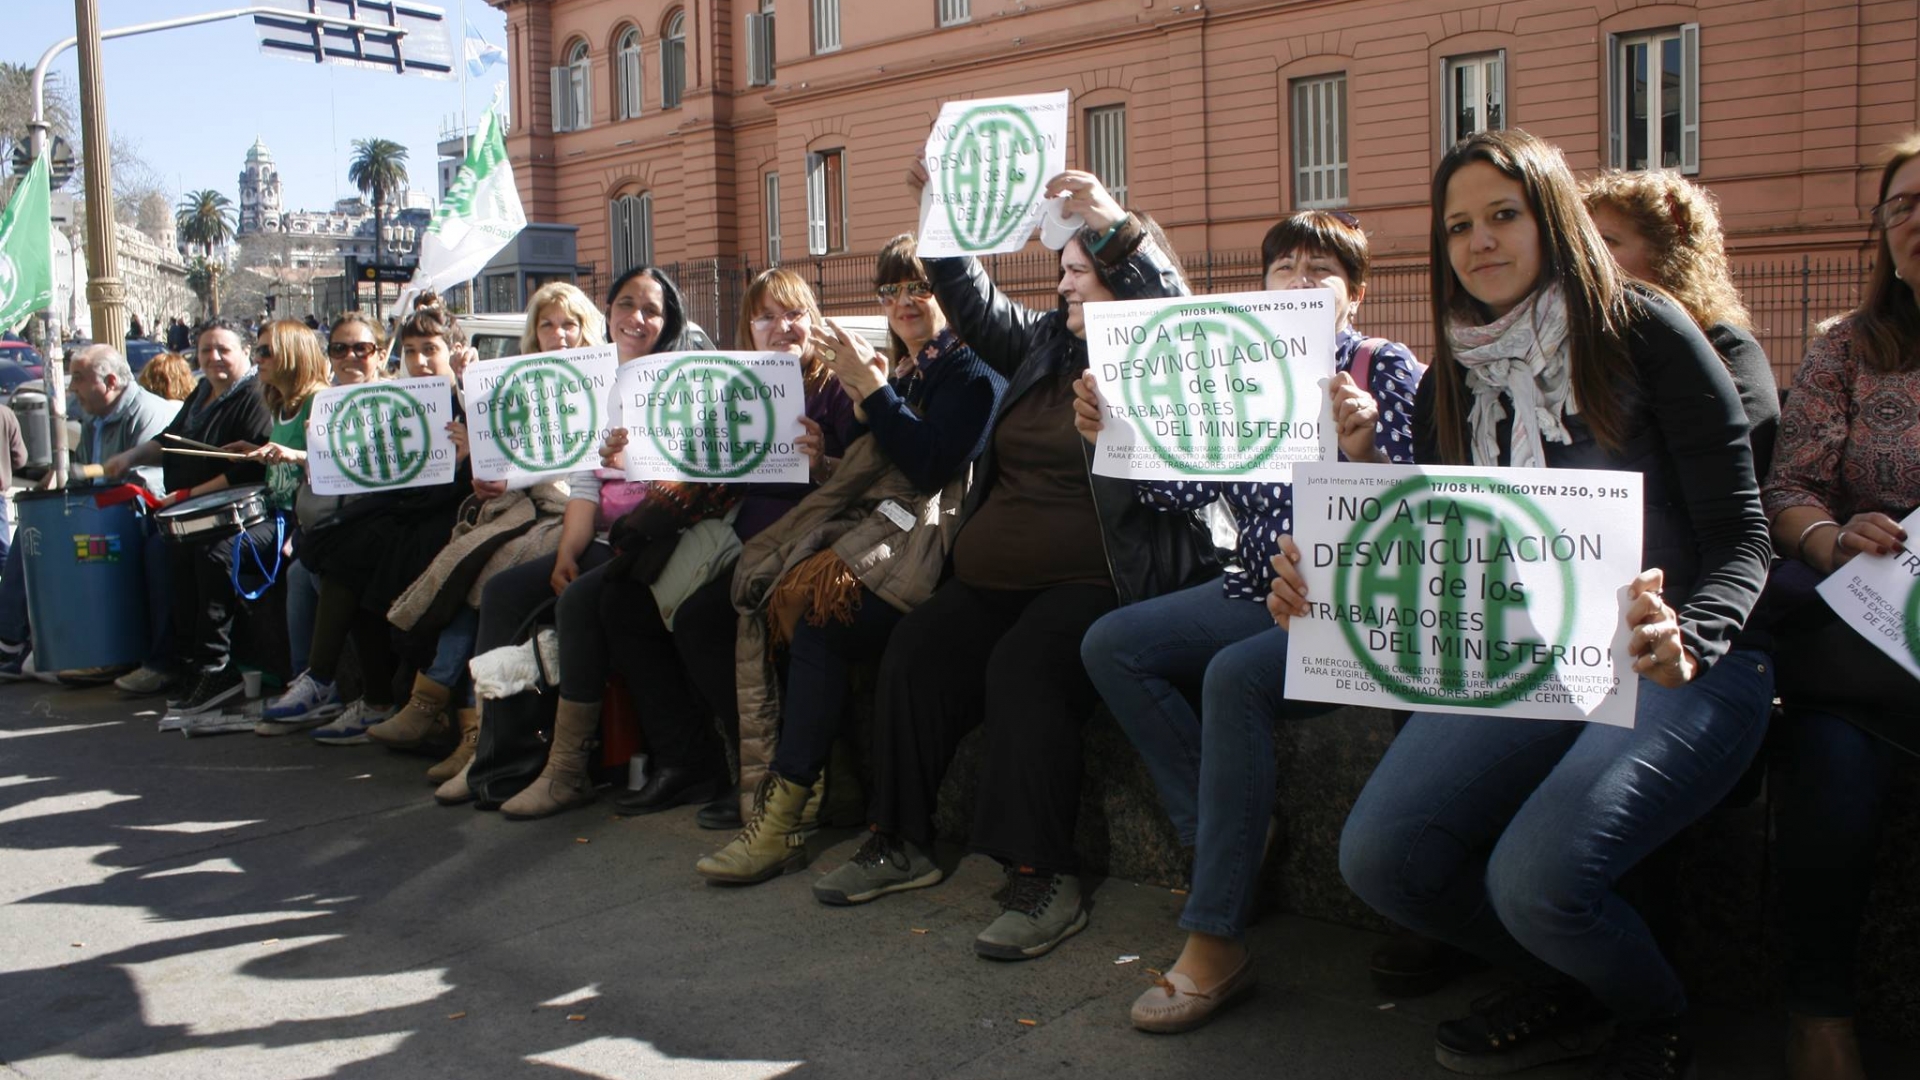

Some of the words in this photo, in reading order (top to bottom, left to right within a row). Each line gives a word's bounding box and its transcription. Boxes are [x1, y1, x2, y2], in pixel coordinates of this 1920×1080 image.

[966, 123, 974, 136] A
[1180, 308, 1206, 318] 17/08
[1208, 307, 1219, 317] H.
[1221, 303, 1271, 315] YRIGOYEN
[1273, 302, 1298, 313] 250,
[1301, 302, 1307, 310] 9
[1309, 300, 1324, 310] HS
[1107, 325, 1147, 346] ¡NO
[1156, 324, 1171, 343] A
[1178, 321, 1207, 341] LA
[1102, 333, 1307, 383] DESVINCULACIÓN
[511, 373, 521, 386] A
[525, 370, 543, 384] LA
[676, 369, 687, 382] A
[693, 369, 713, 382] LA
[1189, 375, 1216, 395] de
[1225, 374, 1258, 393] los
[349, 400, 359, 410] A
[362, 397, 380, 409] LA
[477, 374, 604, 415] DESVINCULACIÓN
[634, 382, 785, 408] DESVINCULACIÓN
[533, 404, 550, 418] de
[556, 402, 576, 416] los
[698, 407, 717, 422] de
[725, 409, 749, 422] los
[1107, 401, 1234, 420] TRABAJADORES
[369, 427, 385, 440] de
[390, 425, 411, 437] los
[478, 420, 560, 442] TRABAJADORES
[510, 438, 534, 450] DEL
[538, 428, 612, 446] MINISTERIO
[631, 426, 729, 439] TRABAJADORES
[1156, 421, 1192, 437] DEL
[1200, 421, 1320, 440] MINISTERIO!
[317, 442, 395, 461] TRABAJADORES
[668, 439, 696, 451] DEL
[702, 440, 795, 455] MINISTERIO!
[348, 457, 371, 468] DEL
[374, 449, 448, 465] MINISTERIO!
[1164, 461, 1226, 470] TRABAJADORES
[1228, 462, 1245, 470] DEL
[1270, 462, 1292, 470] CENT
[1307, 477, 1328, 486] Junta
[1330, 477, 1357, 486] Interna
[1359, 478, 1375, 486] ATE
[1376, 479, 1402, 487] MinEM
[1430, 482, 1467, 493] 17/08
[1471, 484, 1485, 494] H.
[1489, 484, 1557, 496] YRIGOYEN
[1560, 486, 1593, 499] 250,
[1598, 487, 1606, 497] 9
[1610, 488, 1629, 499] HS
[1327, 496, 1382, 523] ¡NO
[1393, 499, 1414, 524] A
[1426, 500, 1463, 527] LA
[1314, 528, 1602, 568] DESVINCULACIÓN
[1893, 546, 1920, 576] TR
[1360, 499, 1540, 694] ATE
[1429, 571, 1467, 598] de
[1481, 574, 1525, 602] los
[1846, 583, 1868, 604] PARA
[1852, 575, 1862, 587] EL
[1862, 584, 1906, 621] MIÉRCOLES
[1308, 602, 1484, 631] TRABAJADORES
[1863, 612, 1880, 626] DE
[1878, 624, 1898, 642] LOS
[1369, 629, 1421, 655] DEL
[1432, 634, 1612, 668] MINISTERIO!
[1302, 656, 1313, 664] EL
[1315, 656, 1364, 670] MIÉRCOLES
[1365, 663, 1390, 672] 17/08
[1392, 665, 1469, 678] CONCENTRAMOS
[1472, 671, 1484, 679] EN
[1487, 671, 1501, 679] LA
[1502, 672, 1541, 682] PUERTA
[1543, 673, 1560, 682] DEL
[1563, 674, 1620, 686] MINISTERIO
[1305, 667, 1328, 676] PARA
[1331, 668, 1370, 680] EXIGIRLE
[1372, 673, 1385, 682] AL
[1387, 674, 1430, 685] MINISTRO
[1433, 677, 1493, 689] ARANGUREN
[1496, 681, 1509, 689] LA
[1511, 682, 1527, 690] NO
[1529, 682, 1618, 695] DESVINCULACIÓN
[1336, 679, 1350, 689] DE
[1354, 681, 1376, 692] LOS
[1381, 683, 1469, 700] TRABAJADORES
[1473, 690, 1496, 700] DEL
[1501, 692, 1531, 703] CALL
[1535, 692, 1589, 705] CENTER.
